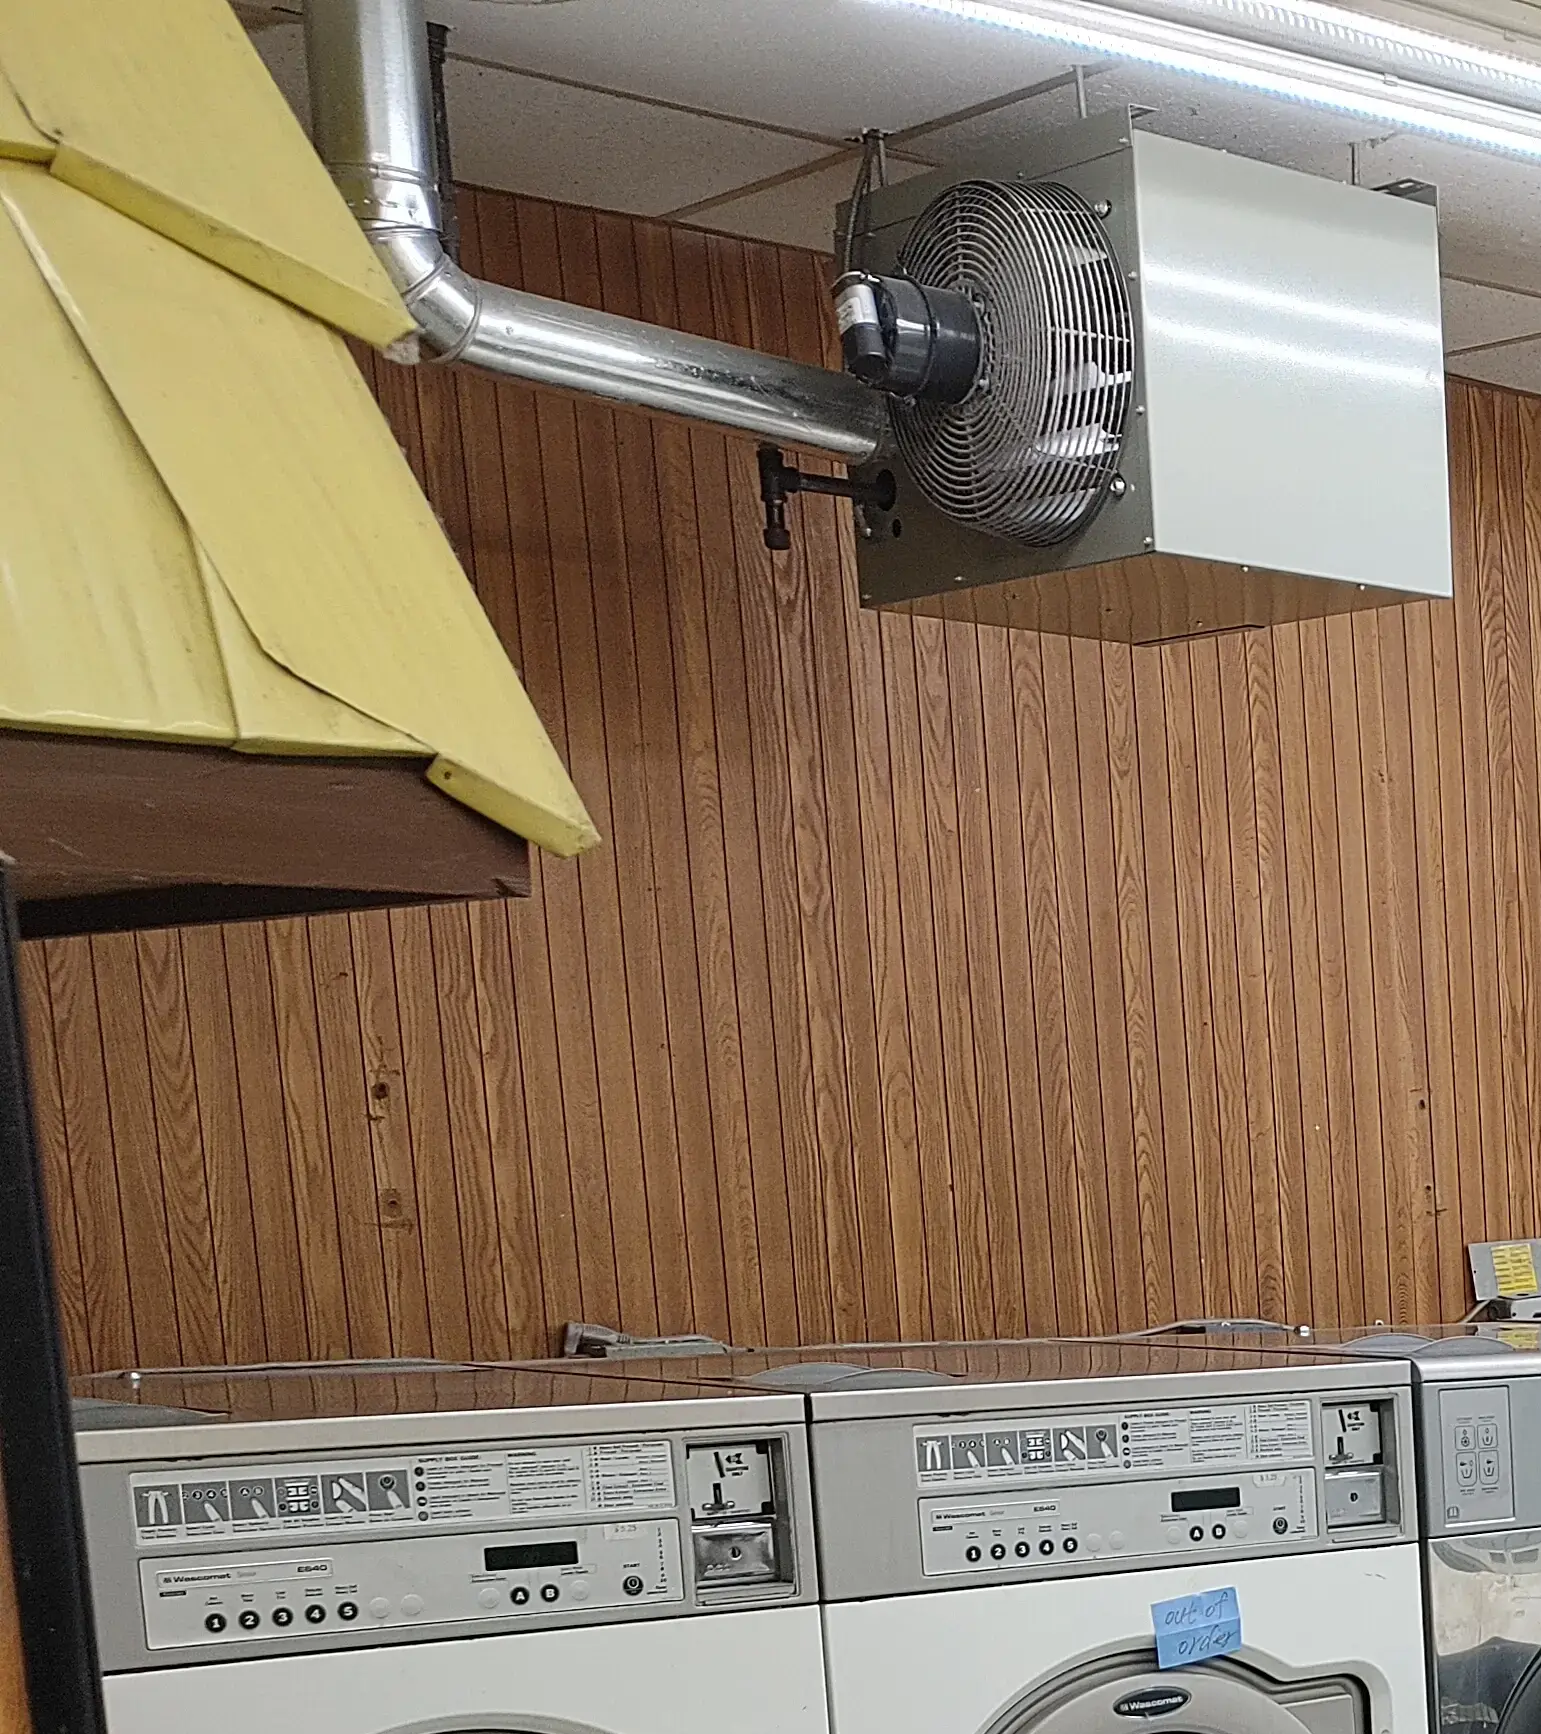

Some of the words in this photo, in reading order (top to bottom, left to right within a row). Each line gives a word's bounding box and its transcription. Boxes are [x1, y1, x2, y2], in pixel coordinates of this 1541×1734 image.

[943, 1511, 985, 1520] Wascomat
[1193, 1529, 1200, 1537] A
[970, 1550, 976, 1558] 1
[995, 1548, 1002, 1556] 2
[1019, 1546, 1026, 1554] 3
[1043, 1543, 1050, 1551] 4
[1067, 1541, 1074, 1549] 5
[173, 1573, 231, 1583] Wascomat
[515, 1592, 525, 1601] A
[545, 1589, 555, 1598] B
[1165, 1603, 1198, 1626] out
[1205, 1591, 1229, 1619] of
[212, 1618, 220, 1628] 1
[245, 1615, 254, 1625] 2
[278, 1612, 288, 1622] 3
[311, 1609, 320, 1619] 4
[344, 1606, 353, 1616] 5
[1129, 1695, 1184, 1711] Wascomat
